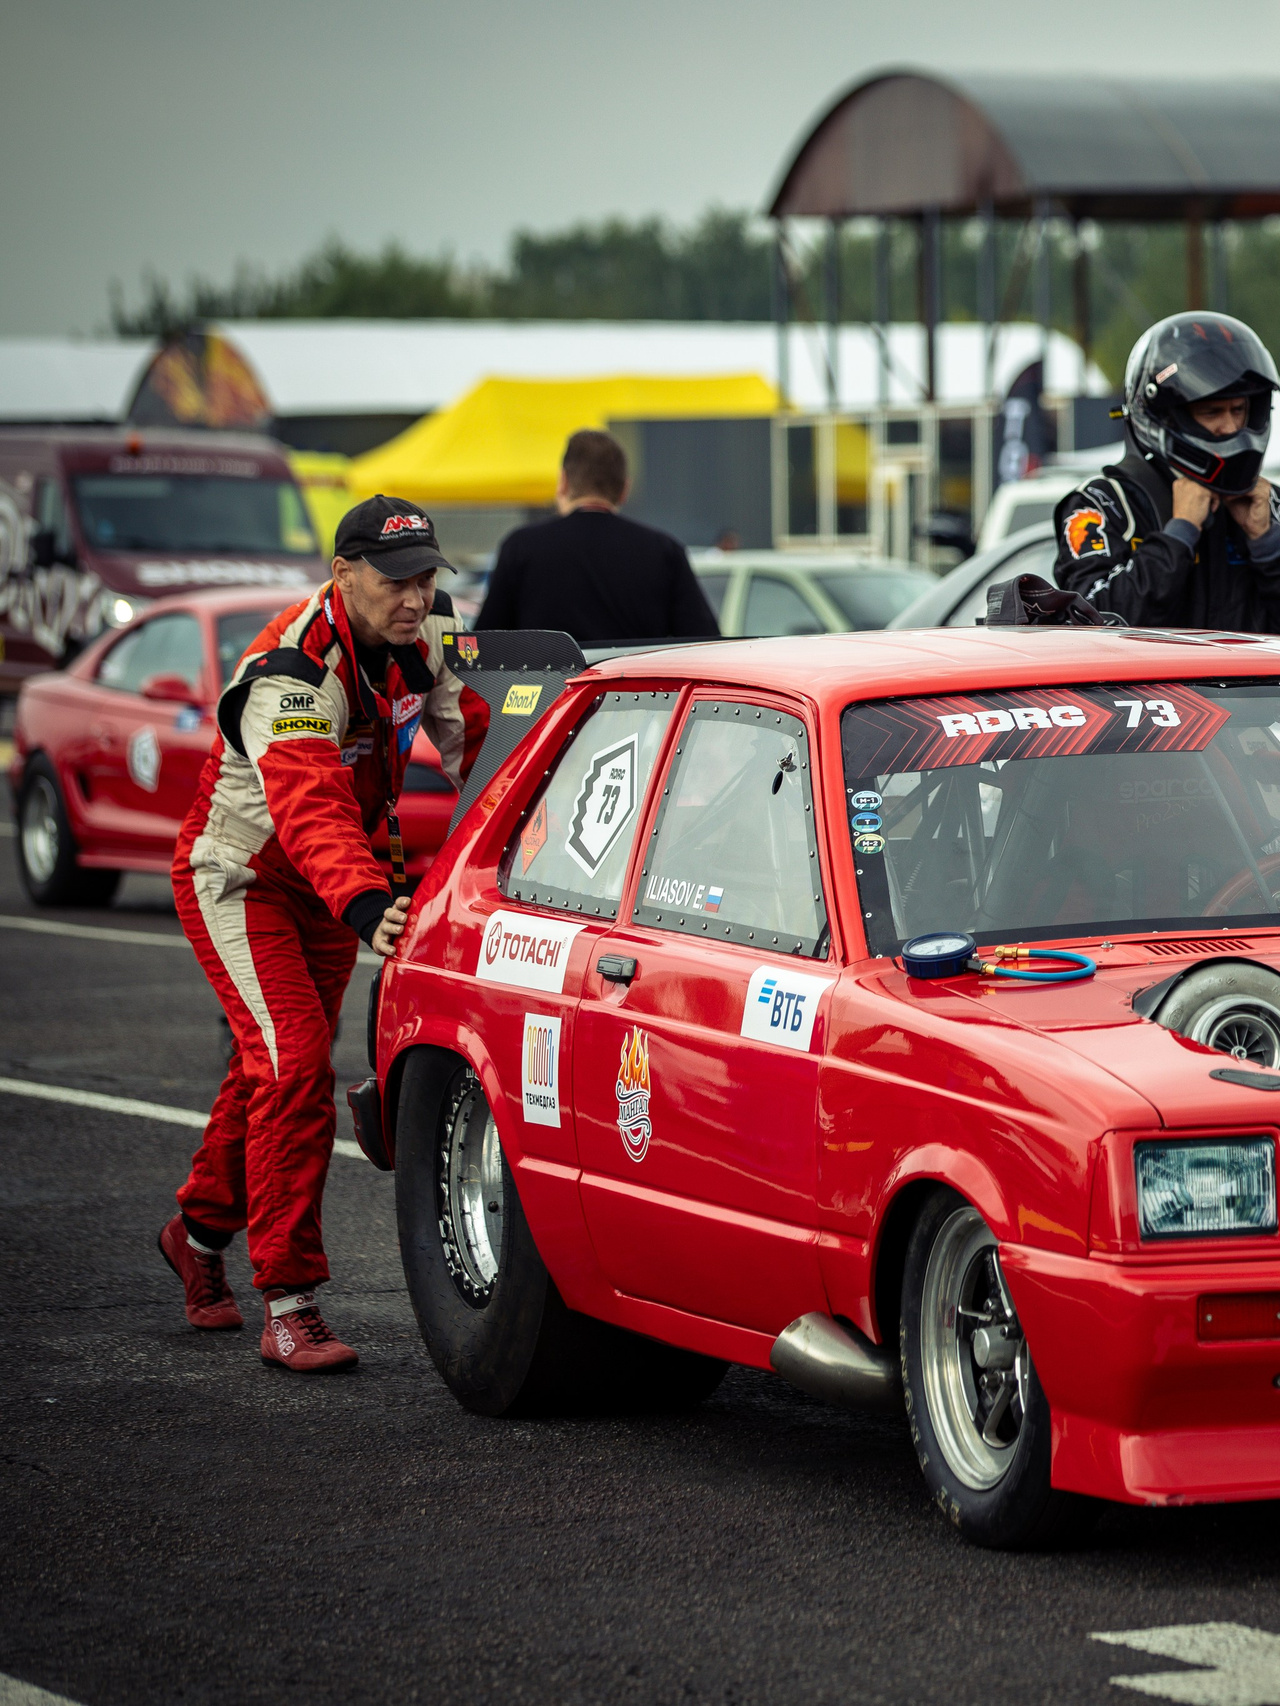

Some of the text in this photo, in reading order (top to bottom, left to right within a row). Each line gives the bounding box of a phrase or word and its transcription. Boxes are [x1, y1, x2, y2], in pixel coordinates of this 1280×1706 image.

[381, 515, 421, 534] AMS
[280, 697, 315, 709] OMP
[506, 690, 538, 709] ShonX
[275, 719, 329, 731] SHONX
[937, 700, 1182, 738] RDRC 73
[596, 784, 621, 825] 73
[646, 875, 696, 907] ILIASOV
[770, 990, 807, 1032] ВТБ
[525, 1092, 556, 1110] ТЕХМЕДГАЗ
[618, 1098, 649, 1120] МАНГАЛ
